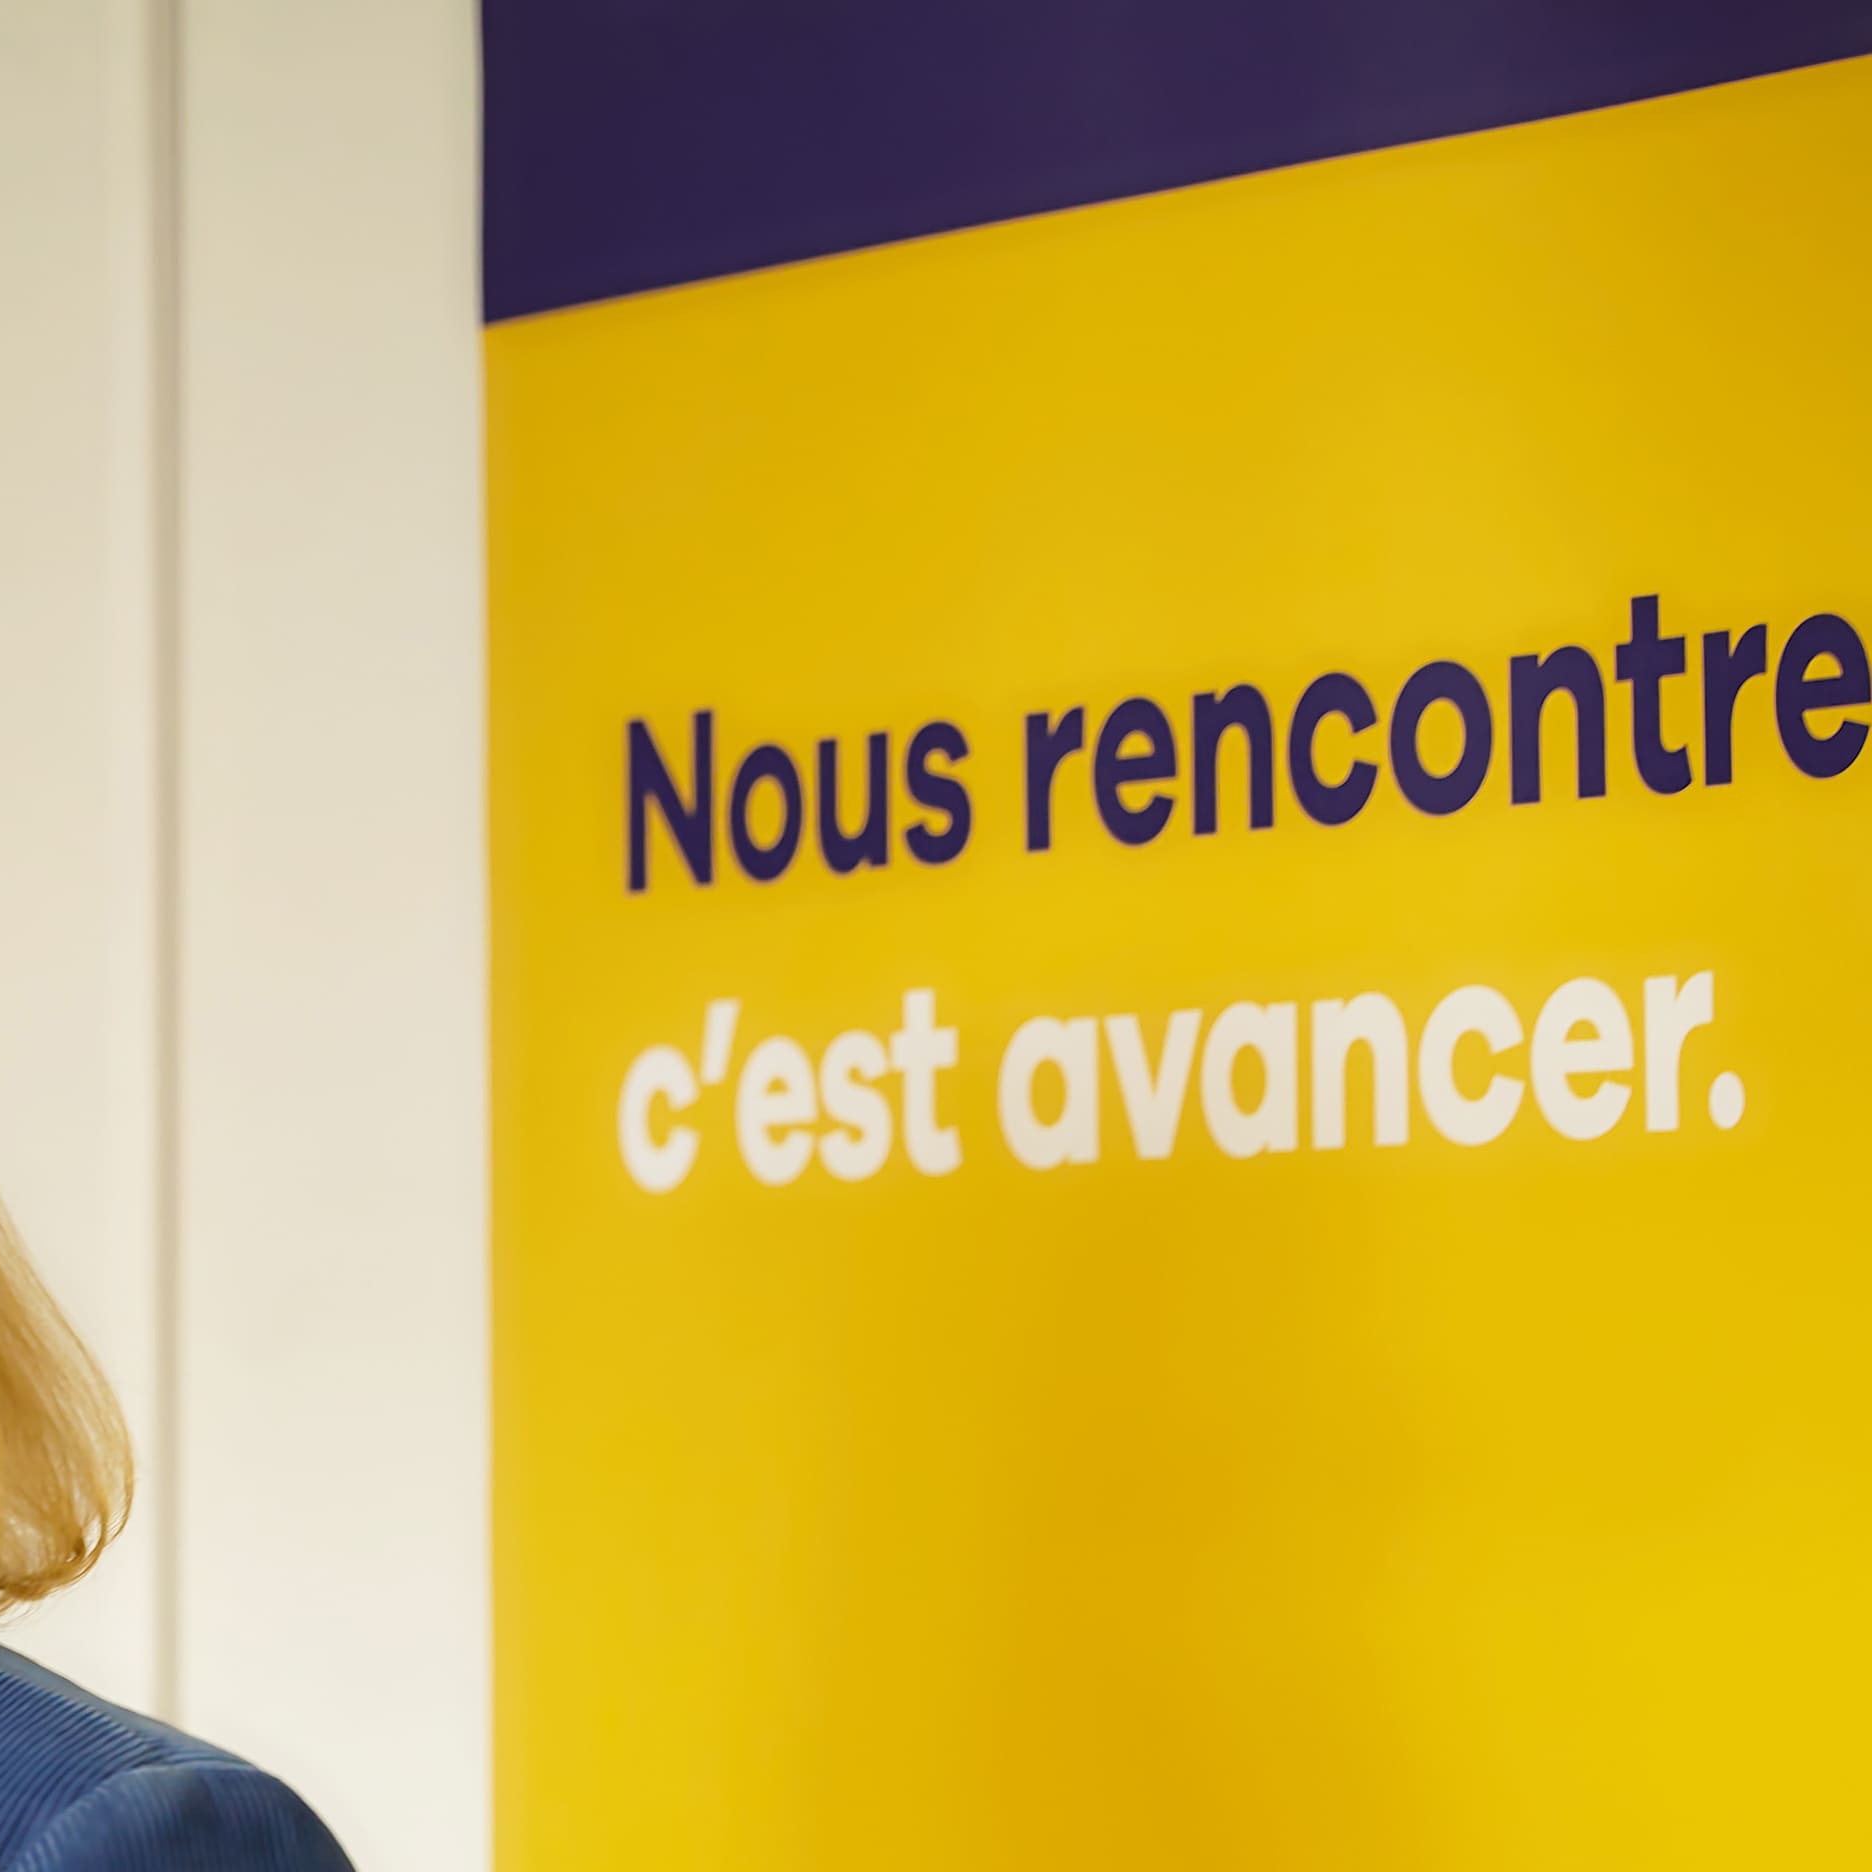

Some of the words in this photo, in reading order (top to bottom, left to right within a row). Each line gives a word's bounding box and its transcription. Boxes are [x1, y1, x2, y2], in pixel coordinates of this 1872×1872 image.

[626, 708, 973, 894] Nous
[1024, 592, 1872, 854] rencontre
[617, 988, 963, 1194] c’est
[997, 970, 1746, 1171] avancer.
